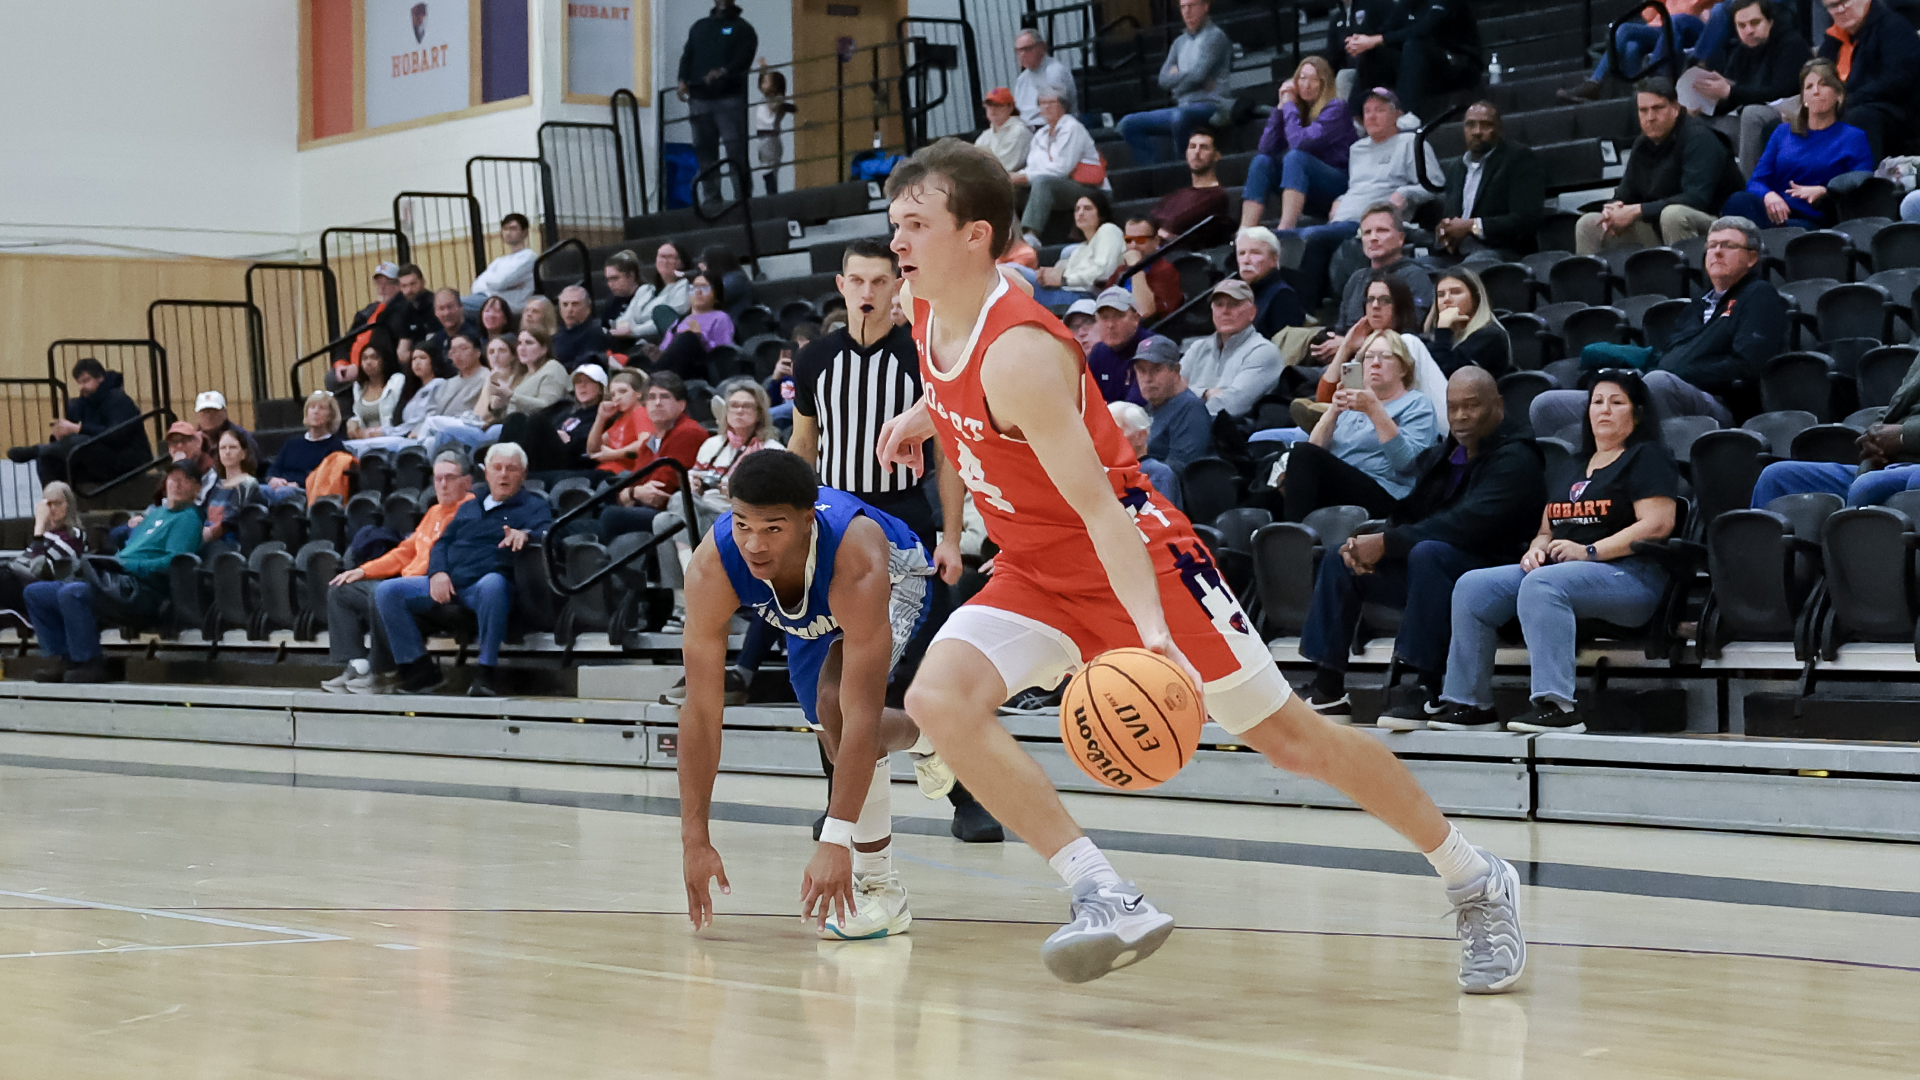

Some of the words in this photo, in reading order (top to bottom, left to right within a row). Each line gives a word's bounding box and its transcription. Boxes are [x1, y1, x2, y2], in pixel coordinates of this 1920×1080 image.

[568, 3, 630, 21] HOBART
[391, 44, 448, 78] HOBART
[955, 436, 1016, 514] 4
[1074, 706, 1133, 787] Wilson
[1114, 704, 1161, 752] EVO
